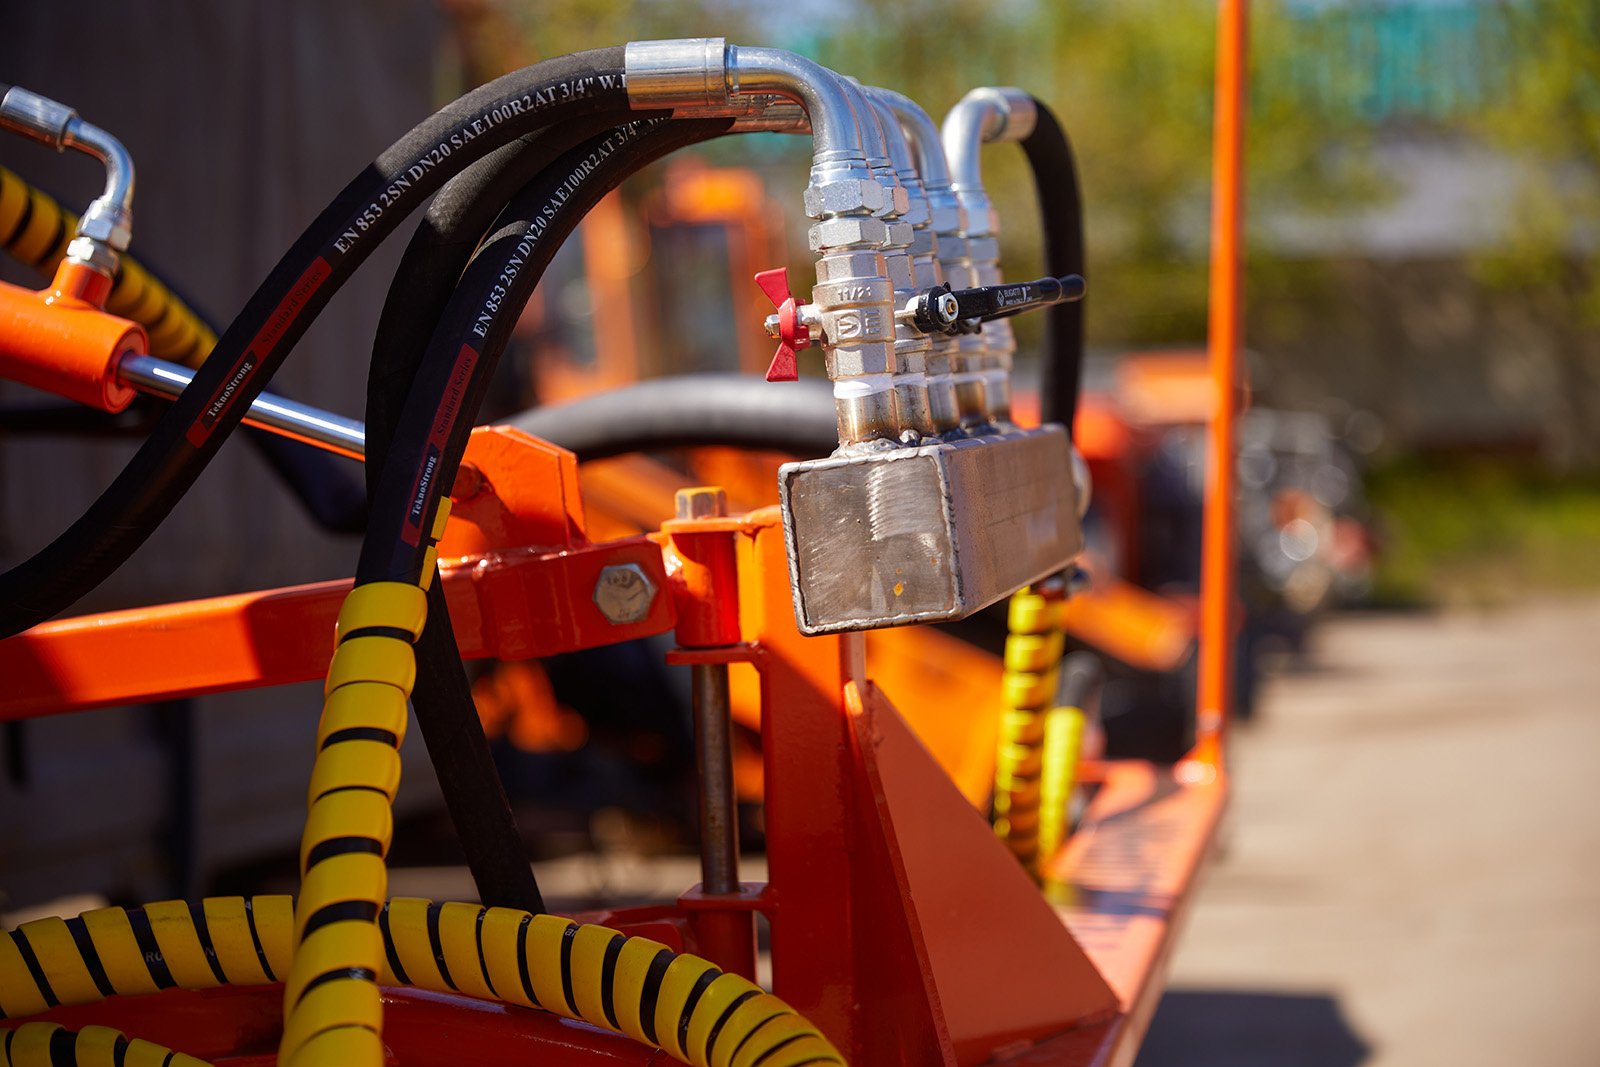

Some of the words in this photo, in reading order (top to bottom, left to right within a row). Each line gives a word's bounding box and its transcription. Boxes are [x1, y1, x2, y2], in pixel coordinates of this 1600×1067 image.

[333, 227, 361, 255] EN
[355, 203, 384, 232] 853
[380, 175, 410, 208] 2SN
[409, 143, 452, 184] DN20
[450, 86, 557, 150] SAE100R2AT
[559, 77, 594, 98] 3/4"
[473, 312, 492, 338] EN
[485, 284, 506, 313] 853
[500, 254, 526, 287] 2SN
[517, 216, 547, 258] DN20
[542, 138, 615, 220] SAE100R2AT
[207, 361, 252, 418] TeknoStrong
[262, 299, 298, 345] Standard
[296, 270, 322, 297] Series
[412, 456, 437, 516] TeknoStrong
[437, 388, 459, 436] Standard
[454, 356, 472, 386] Series
